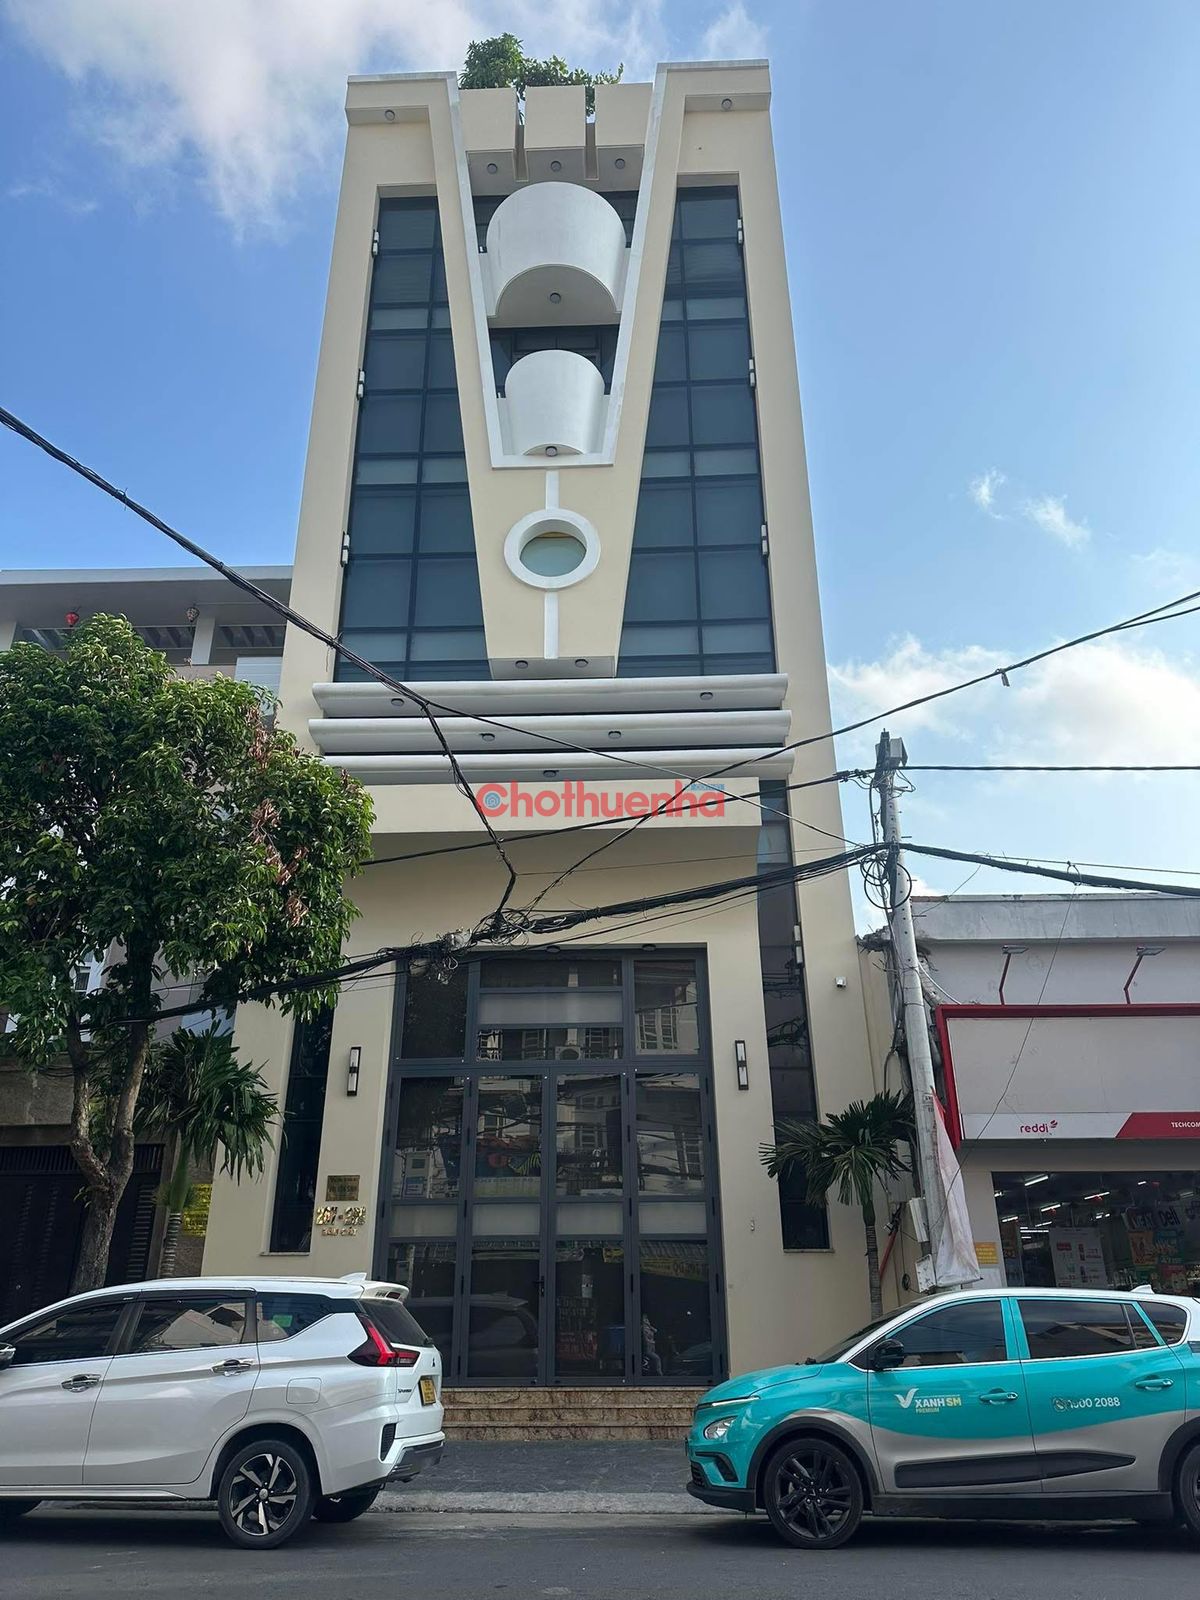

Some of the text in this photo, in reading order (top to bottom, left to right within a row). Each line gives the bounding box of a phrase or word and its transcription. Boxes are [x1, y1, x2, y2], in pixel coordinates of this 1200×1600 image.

[1019, 1123, 1049, 1133] reddi
[915, 1397, 962, 1409] XANH SM
[1094, 1397, 1121, 1408] 2088
